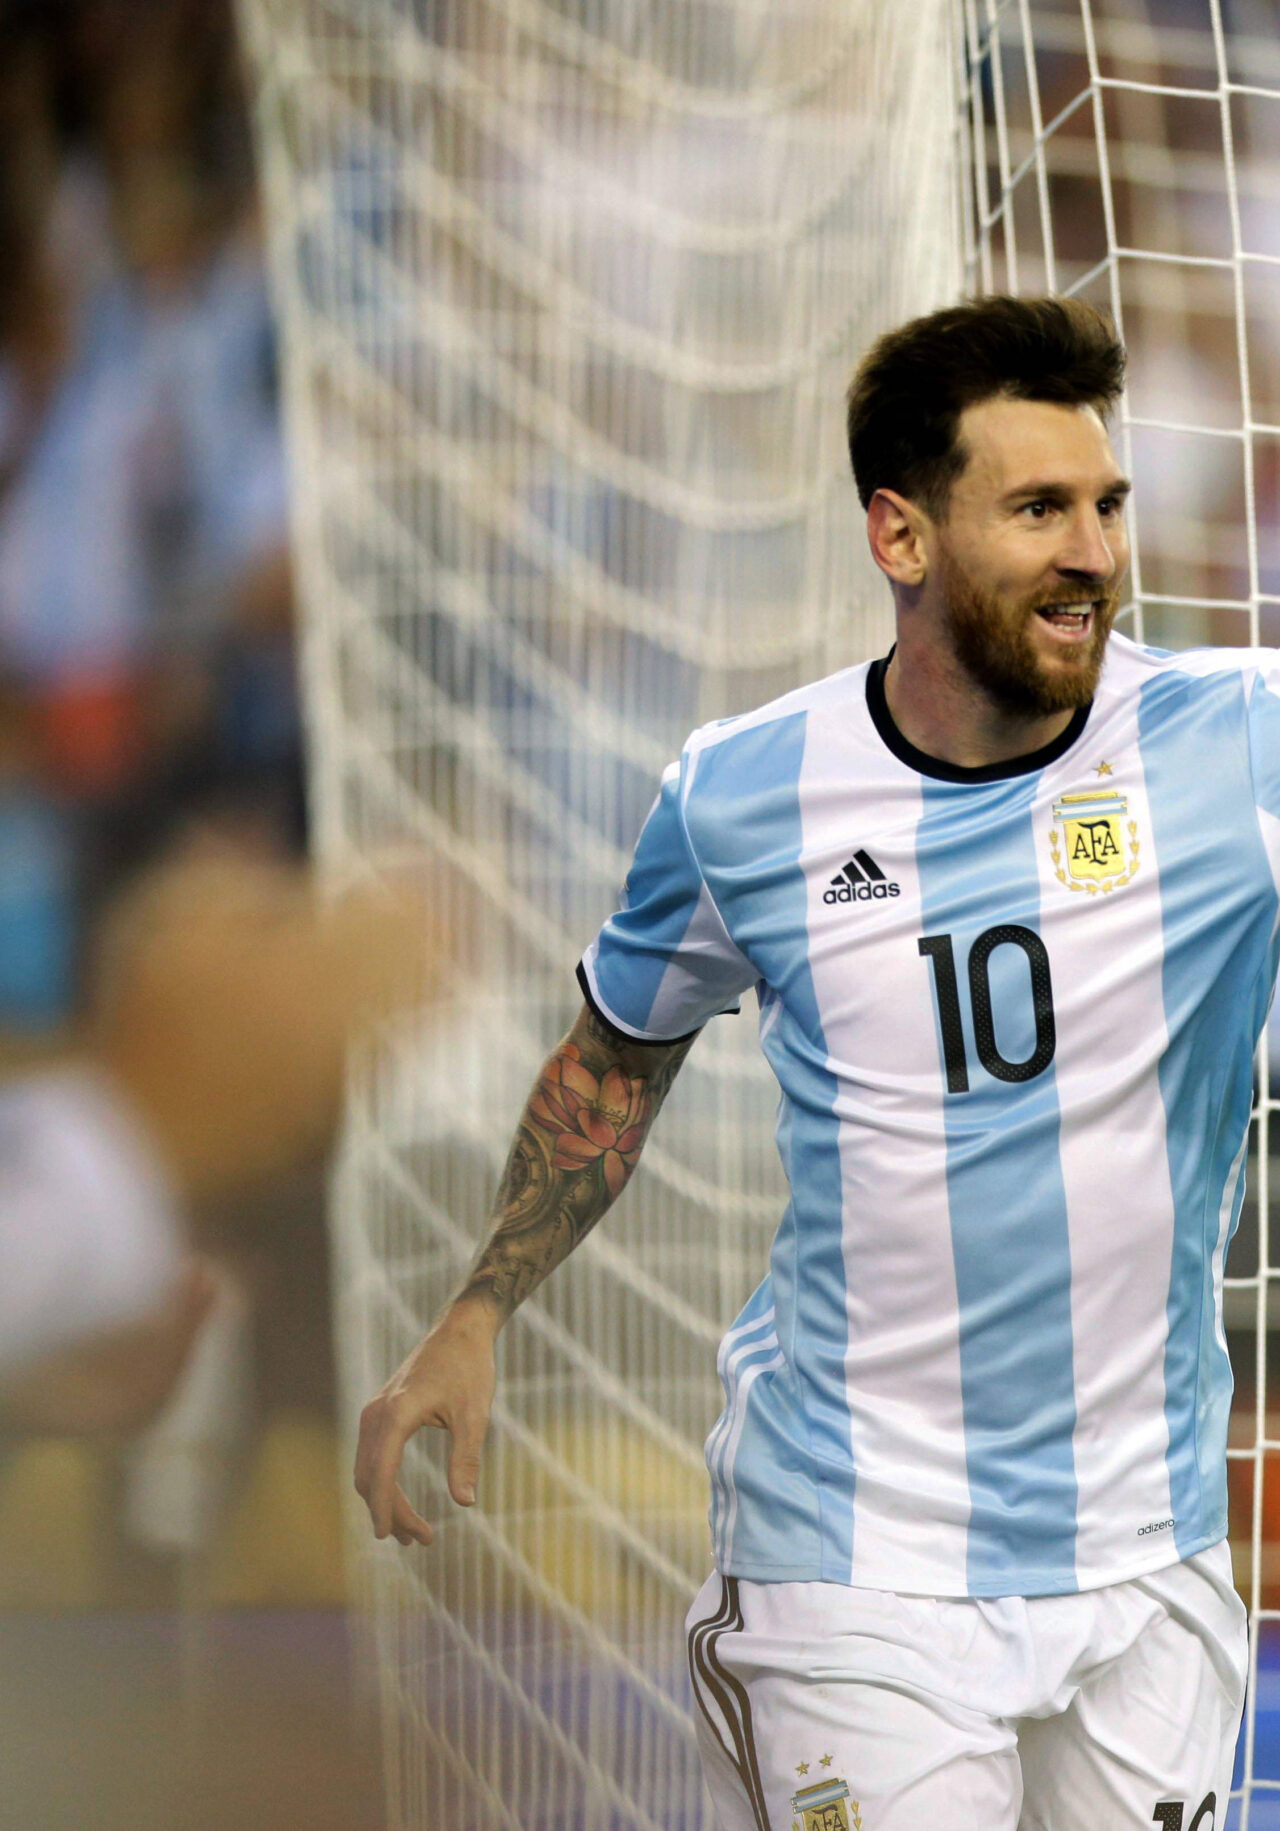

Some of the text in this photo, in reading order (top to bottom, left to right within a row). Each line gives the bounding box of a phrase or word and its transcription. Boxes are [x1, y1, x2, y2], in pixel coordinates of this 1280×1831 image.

[1072, 820, 1120, 866] AFA
[824, 881, 901, 905] adidas
[918, 924, 1057, 1095] 10
[1137, 1519, 1176, 1537] adizero
